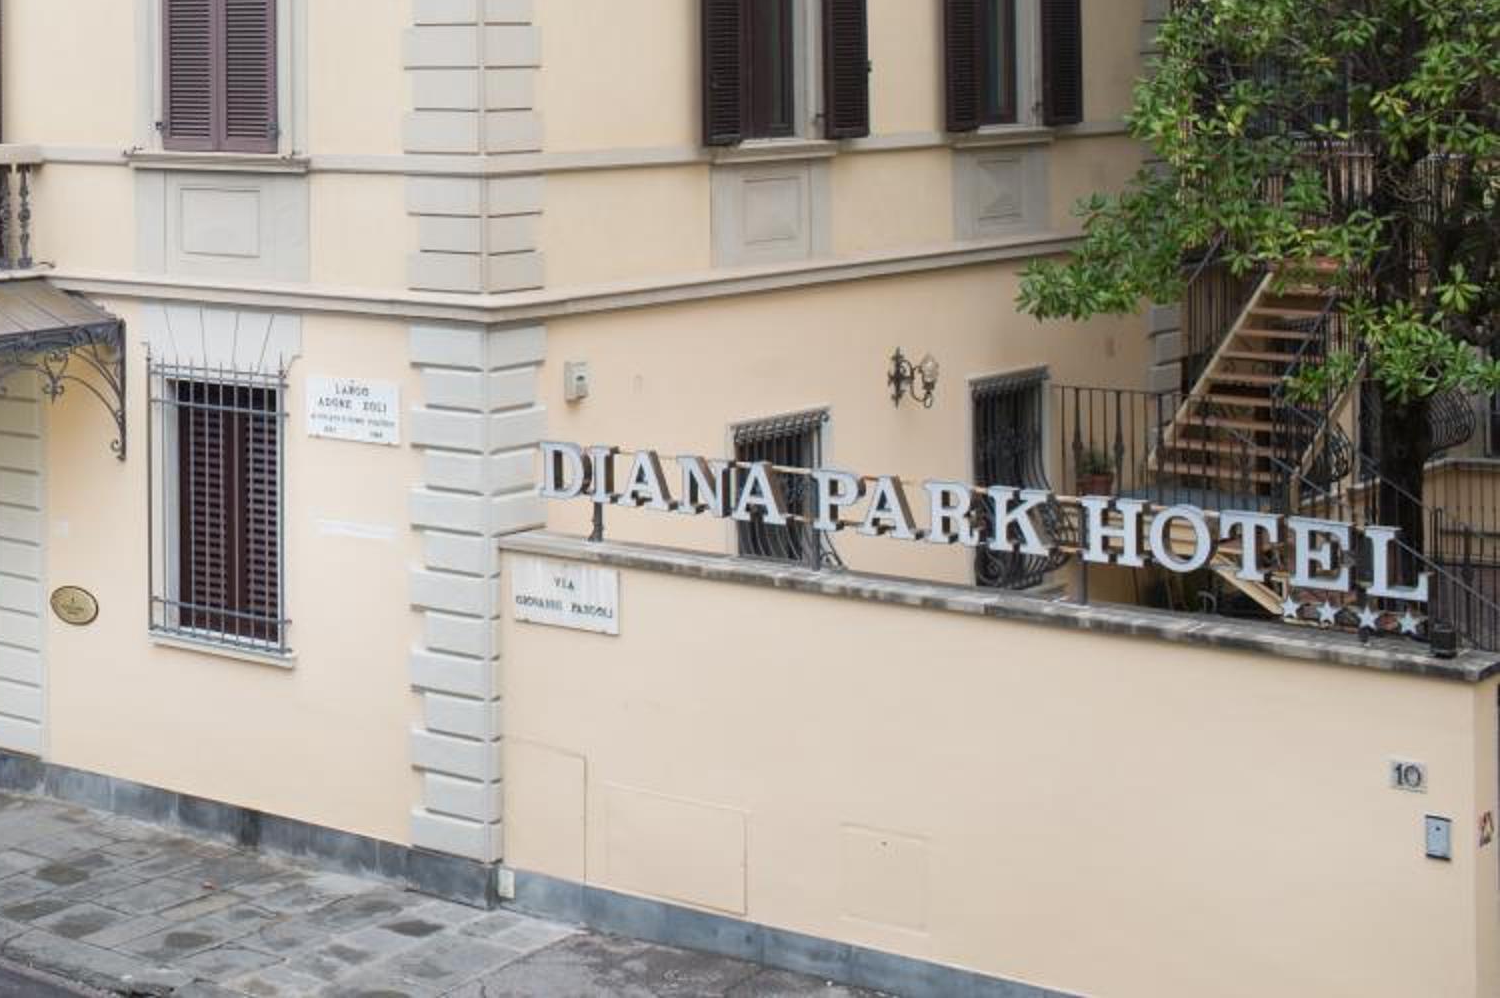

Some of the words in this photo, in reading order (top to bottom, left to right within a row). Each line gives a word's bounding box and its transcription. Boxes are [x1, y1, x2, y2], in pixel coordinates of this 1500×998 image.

[335, 383, 369, 396] LARGO
[535, 440, 791, 526] DIANA
[812, 468, 1053, 556] PARK
[1076, 494, 1433, 603] HOTEL
[553, 577, 575, 590] VIA
[1395, 762, 1422, 789] 10
